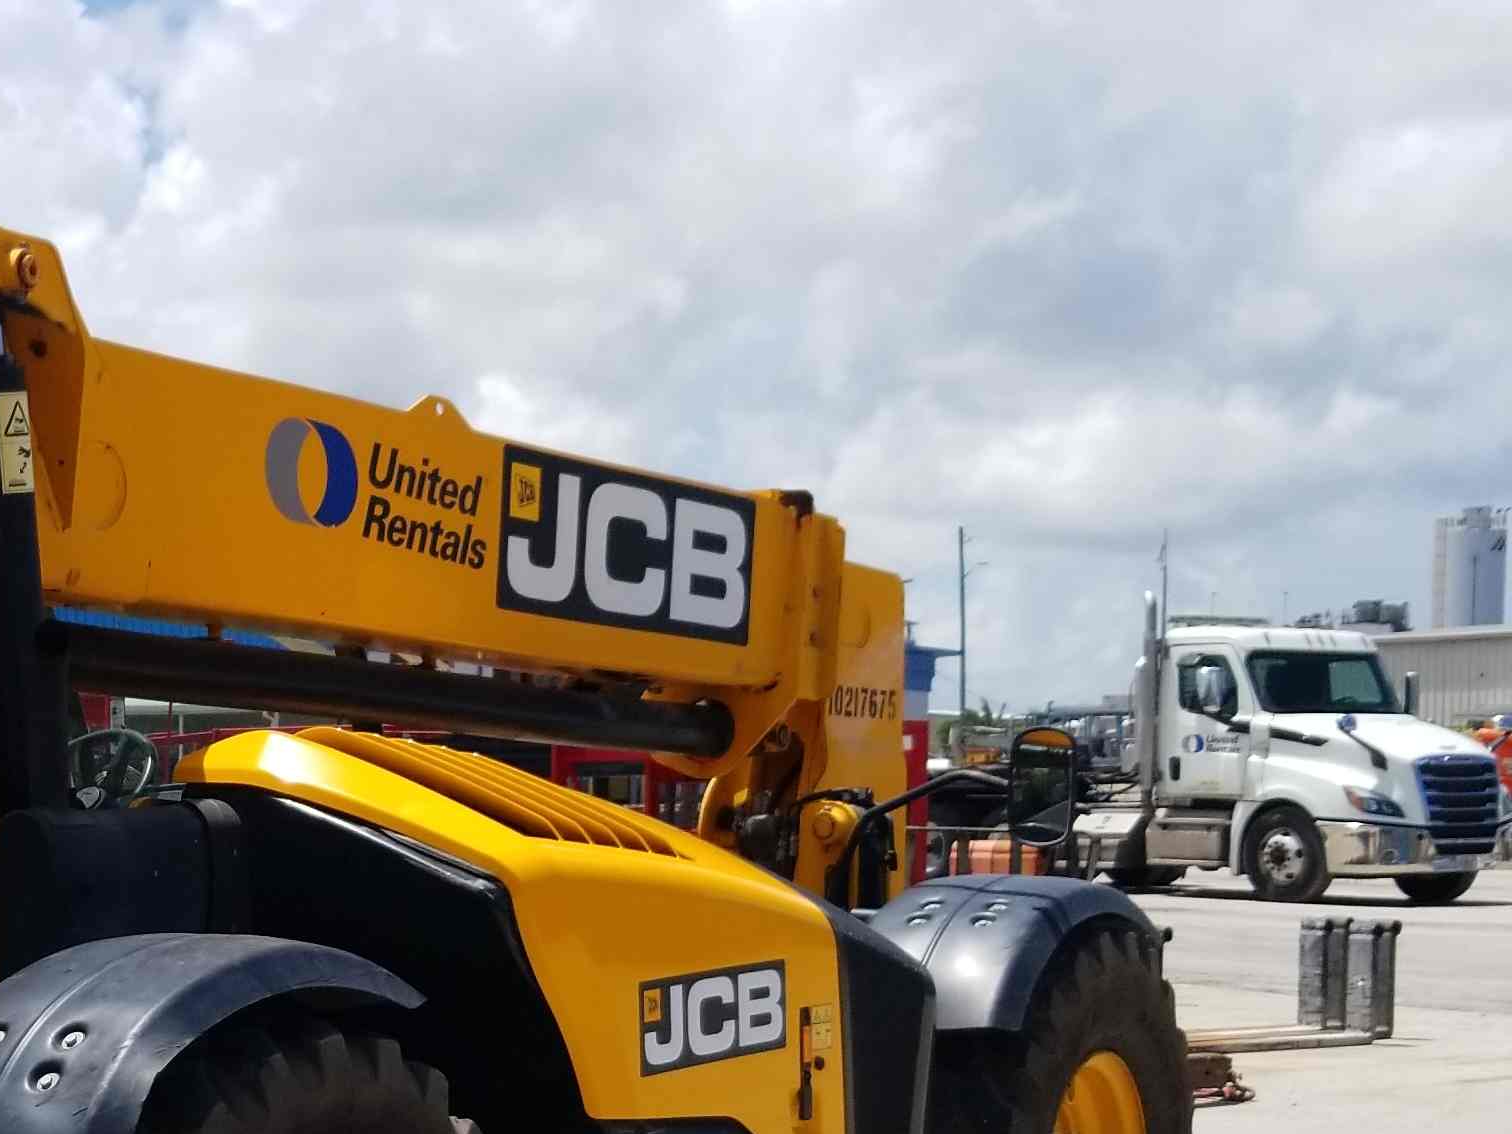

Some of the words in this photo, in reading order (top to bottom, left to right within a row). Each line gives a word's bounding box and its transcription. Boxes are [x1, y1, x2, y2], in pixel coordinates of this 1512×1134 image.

[367, 442, 483, 517] United
[362, 495, 487, 570] Rentals
[506, 473, 747, 630] JCB
[644, 969, 783, 1066] JCB
